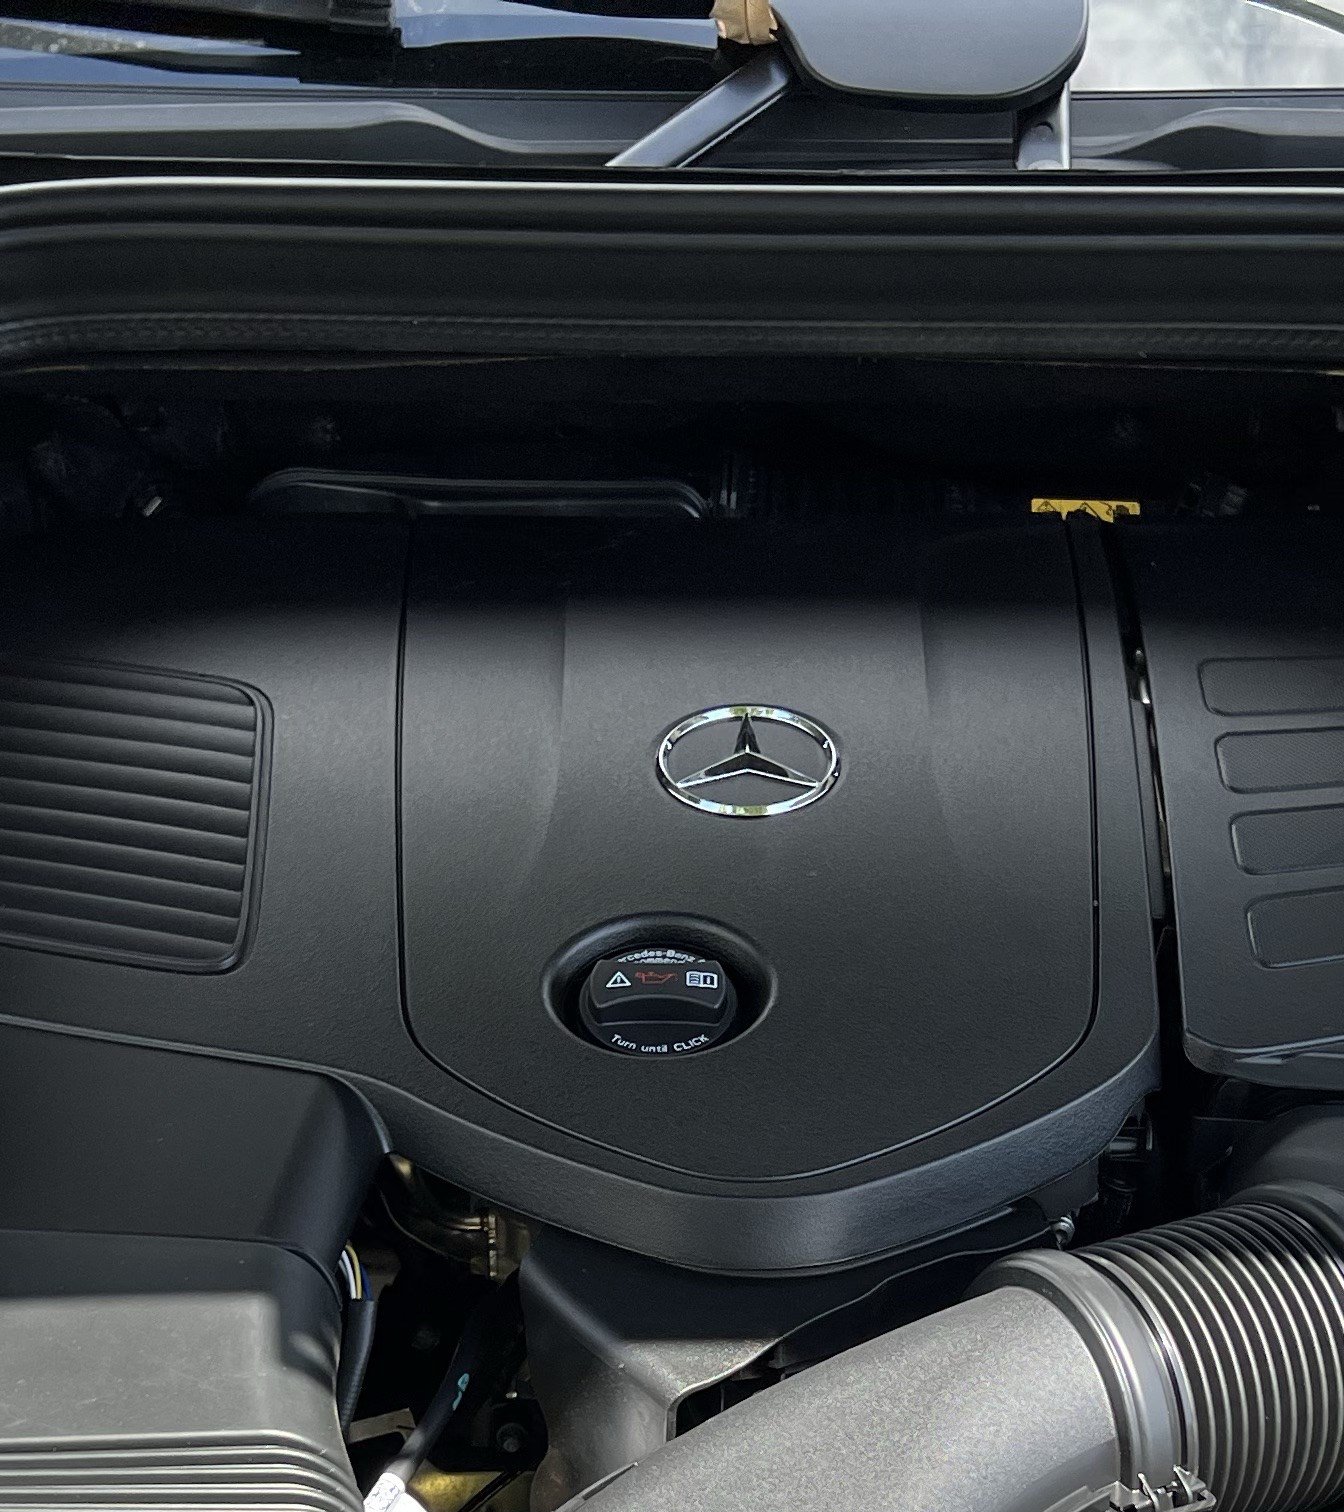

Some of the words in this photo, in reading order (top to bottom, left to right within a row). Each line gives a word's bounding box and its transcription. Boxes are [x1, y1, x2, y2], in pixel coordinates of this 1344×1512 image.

[611, 1034, 637, 1050] Turn
[641, 1044, 668, 1053] until
[673, 1034, 710, 1052] CLICK
